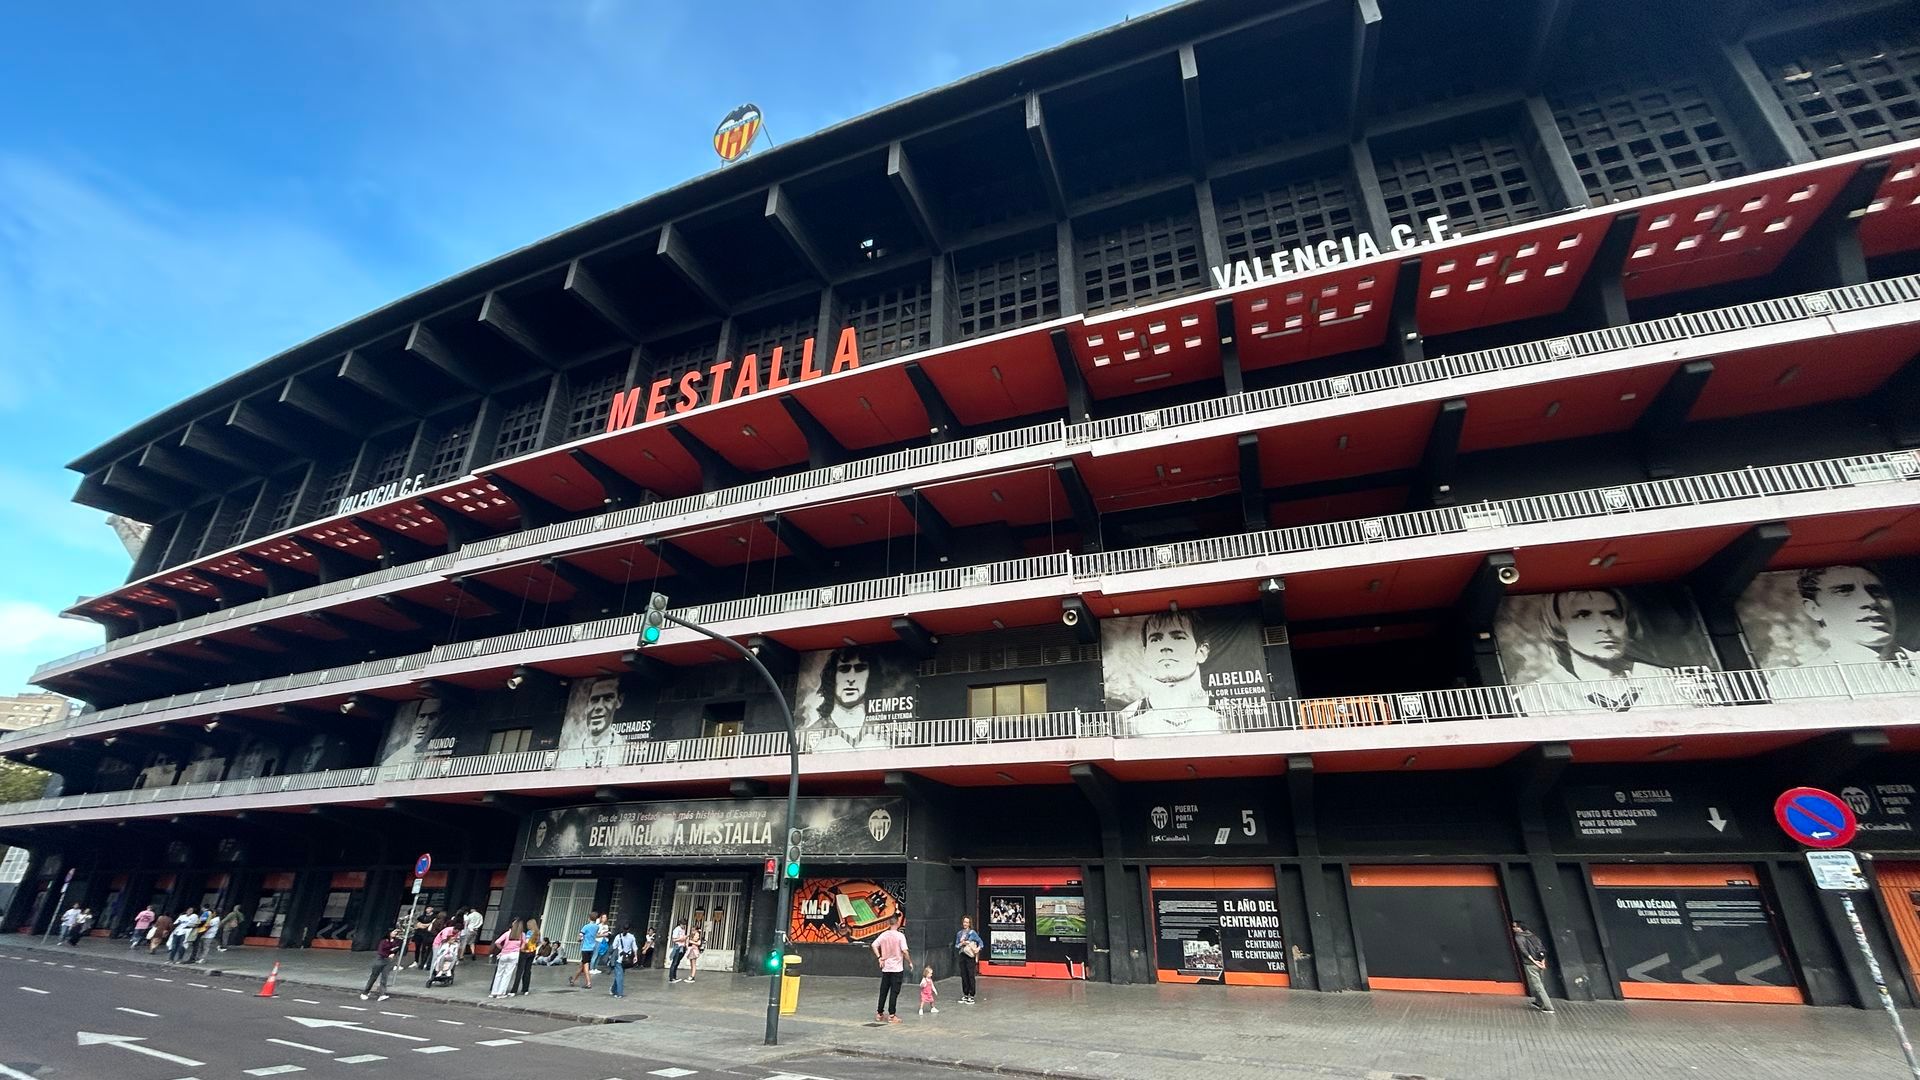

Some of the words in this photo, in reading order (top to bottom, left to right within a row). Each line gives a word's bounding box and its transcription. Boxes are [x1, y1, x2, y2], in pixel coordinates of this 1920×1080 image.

[1211, 232, 1381, 289] VALENCIA
[1391, 214, 1462, 250] C.F.
[607, 326, 860, 433] MESTALLA
[338, 482, 398, 515] VALENCIA
[1208, 669, 1264, 687] ALBELDA
[1215, 689, 1229, 697] COR
[1234, 686, 1266, 695] LLEGENDA
[868, 696, 913, 712] KEMPES
[1215, 696, 1267, 709] MESTALLA
[428, 737, 456, 750] MUNDO
[1631, 789, 1672, 798] MESTALLA
[1175, 805, 1199, 813] PUERTA
[1576, 810, 1601, 818] PUNTO
[1601, 810, 1613, 818] DE
[1612, 809, 1657, 817] ENCUENTRO
[620, 813, 636, 822] 1923
[1242, 810, 1257, 836] 5
[673, 823, 684, 846] A
[688, 822, 772, 845] MESTALLA
[1223, 900, 1236, 912] EL
[1237, 898, 1257, 912] AÑO
[1258, 900, 1278, 912] DEL
[1616, 898, 1645, 909] ÚLTIMA
[1645, 898, 1678, 909] DÉCADA
[1219, 915, 1279, 928] CENTENARIO
[1247, 929, 1267, 938] L'ANY
[1268, 930, 1282, 938] DEL
[1245, 940, 1283, 949] CENTENARI
[1231, 950, 1244, 959] THE
[1245, 950, 1284, 960] CENTENARY
[1267, 961, 1286, 971] YEAR
